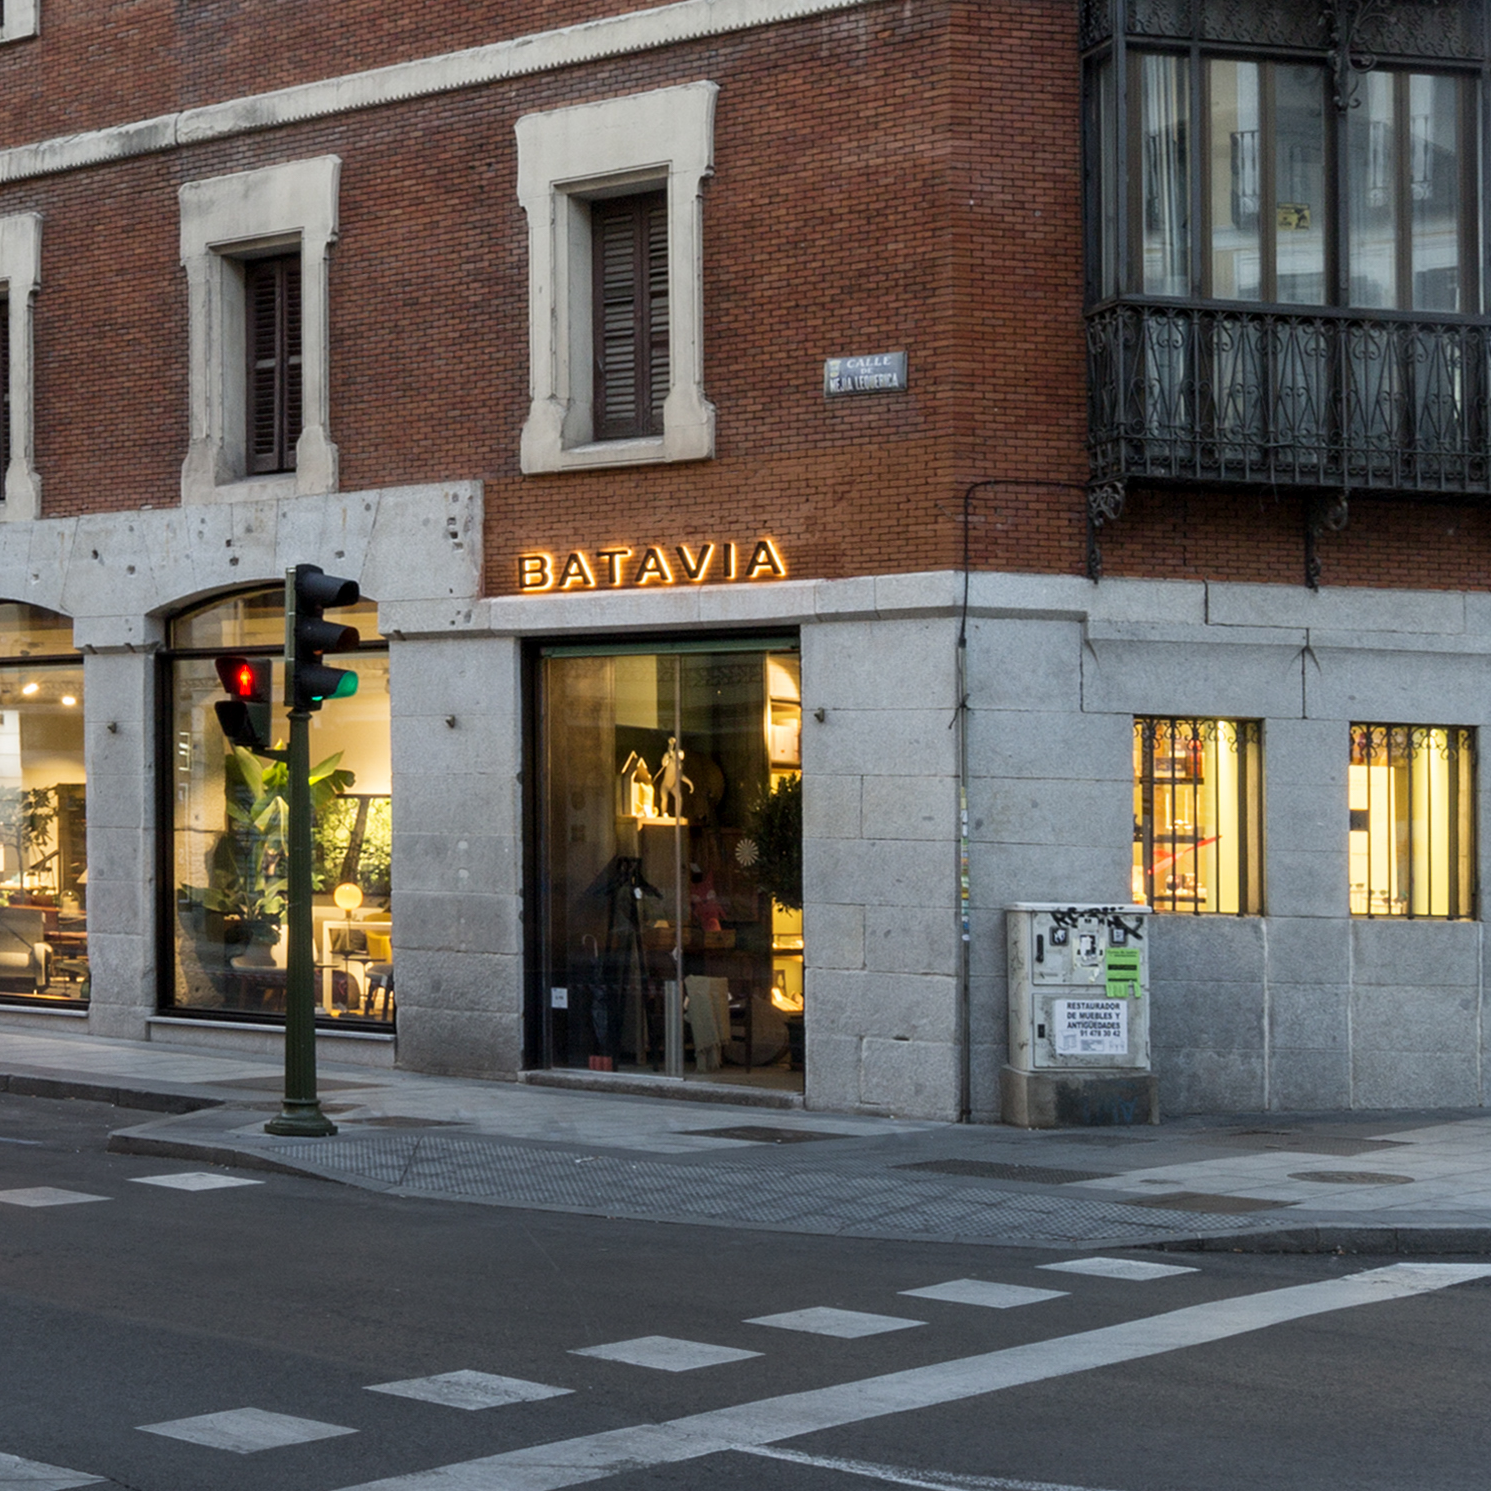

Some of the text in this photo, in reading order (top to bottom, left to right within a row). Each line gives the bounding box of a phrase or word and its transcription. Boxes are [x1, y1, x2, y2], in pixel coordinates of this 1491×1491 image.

[847, 356, 892, 369] CALLE
[518, 539, 787, 592] BATAVIA
[1066, 1002, 1120, 1010] RESTAURADOR
[1066, 1012, 1121, 1020] DE MUEBLES Y
[1066, 1021, 1121, 1029] ANTIGÜEDADES
